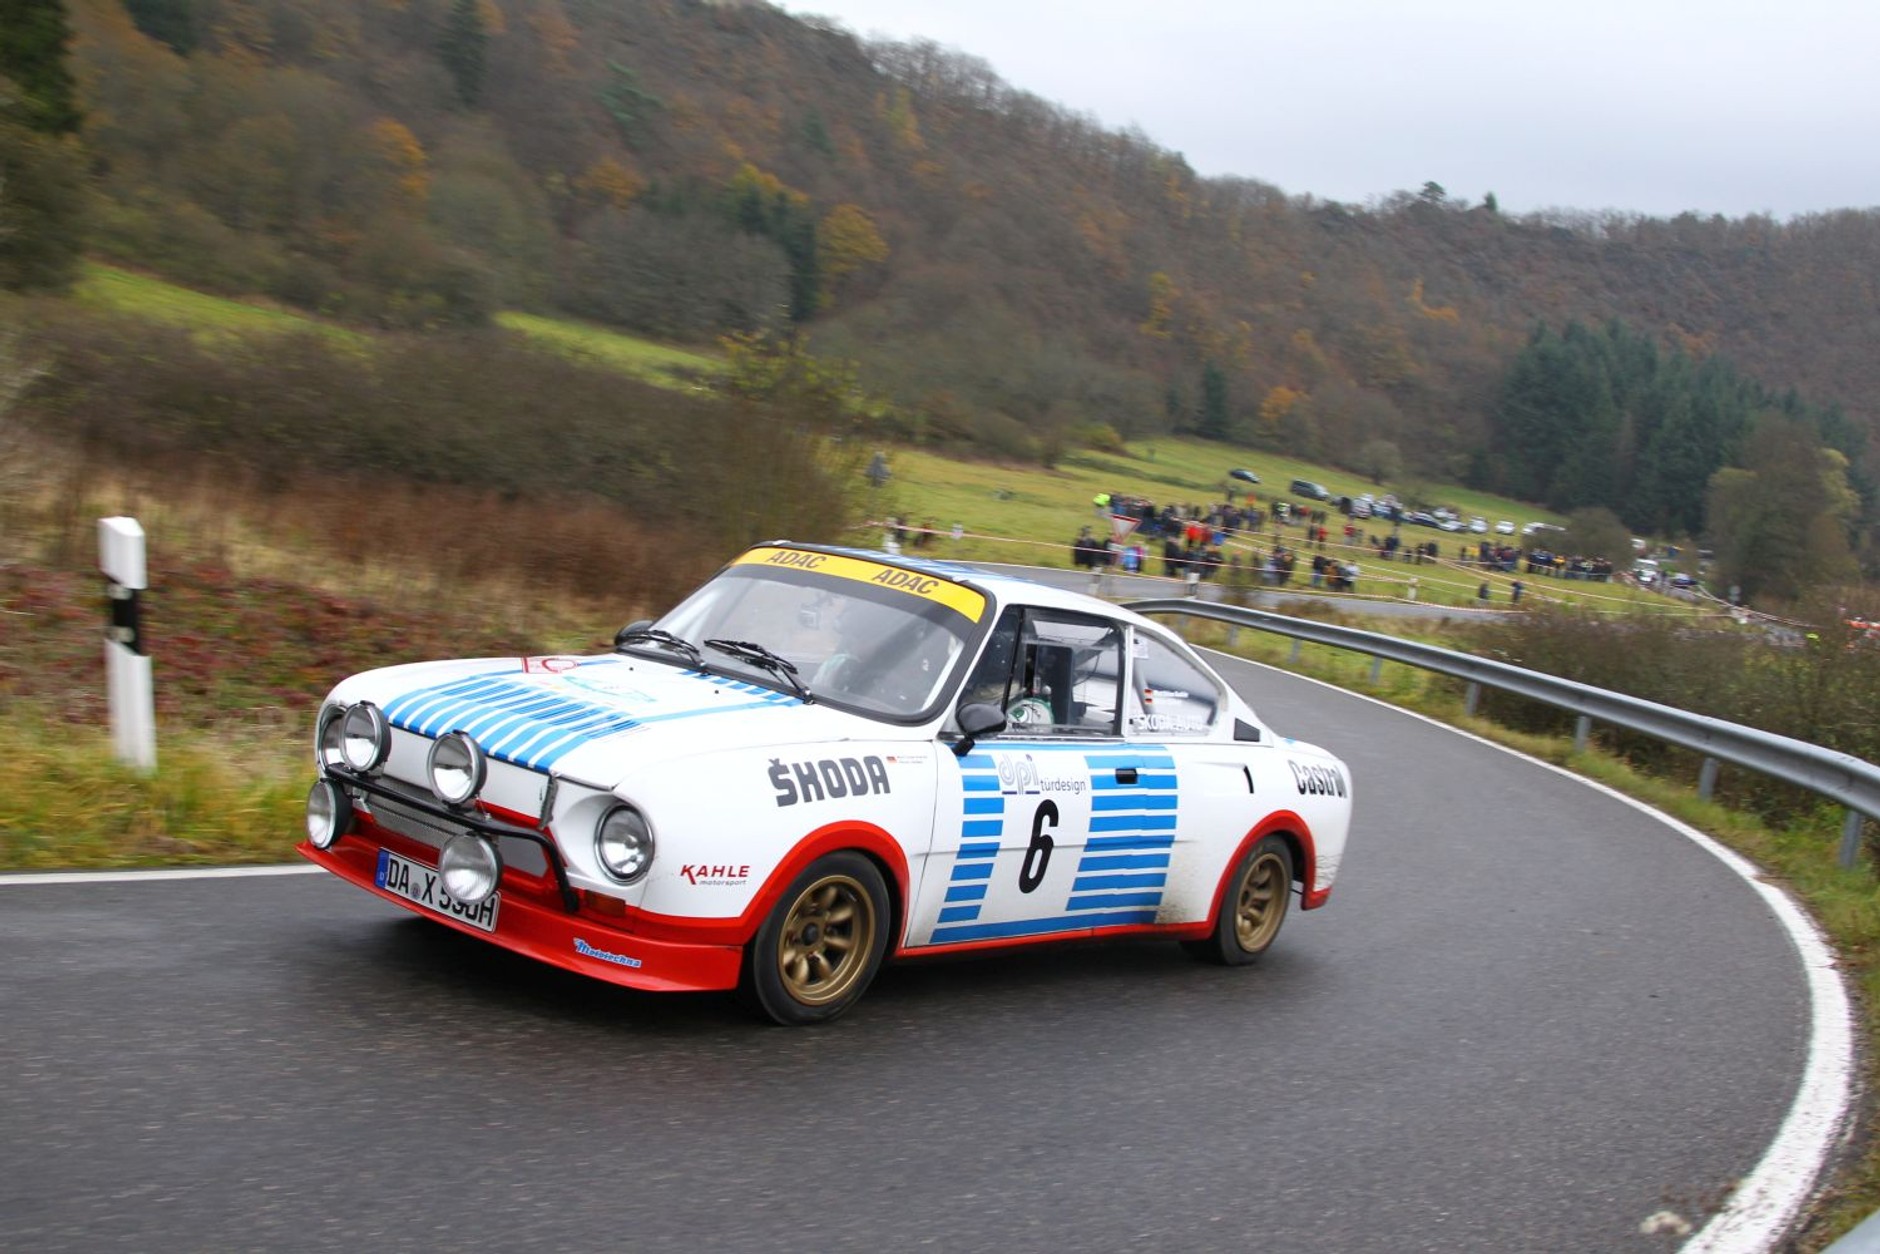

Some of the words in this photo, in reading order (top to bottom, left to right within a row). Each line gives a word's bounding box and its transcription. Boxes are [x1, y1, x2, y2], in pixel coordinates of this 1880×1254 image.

[767, 551, 828, 568] ADAC
[872, 568, 939, 595] ADAC
[767, 755, 891, 807] ŠKODA
[999, 753, 1039, 794] dpi
[1018, 799, 1059, 894] 6
[387, 859, 409, 894] DA
[421, 872, 437, 905] X
[680, 864, 750, 885] KAHLE
[699, 879, 747, 887] motorsport
